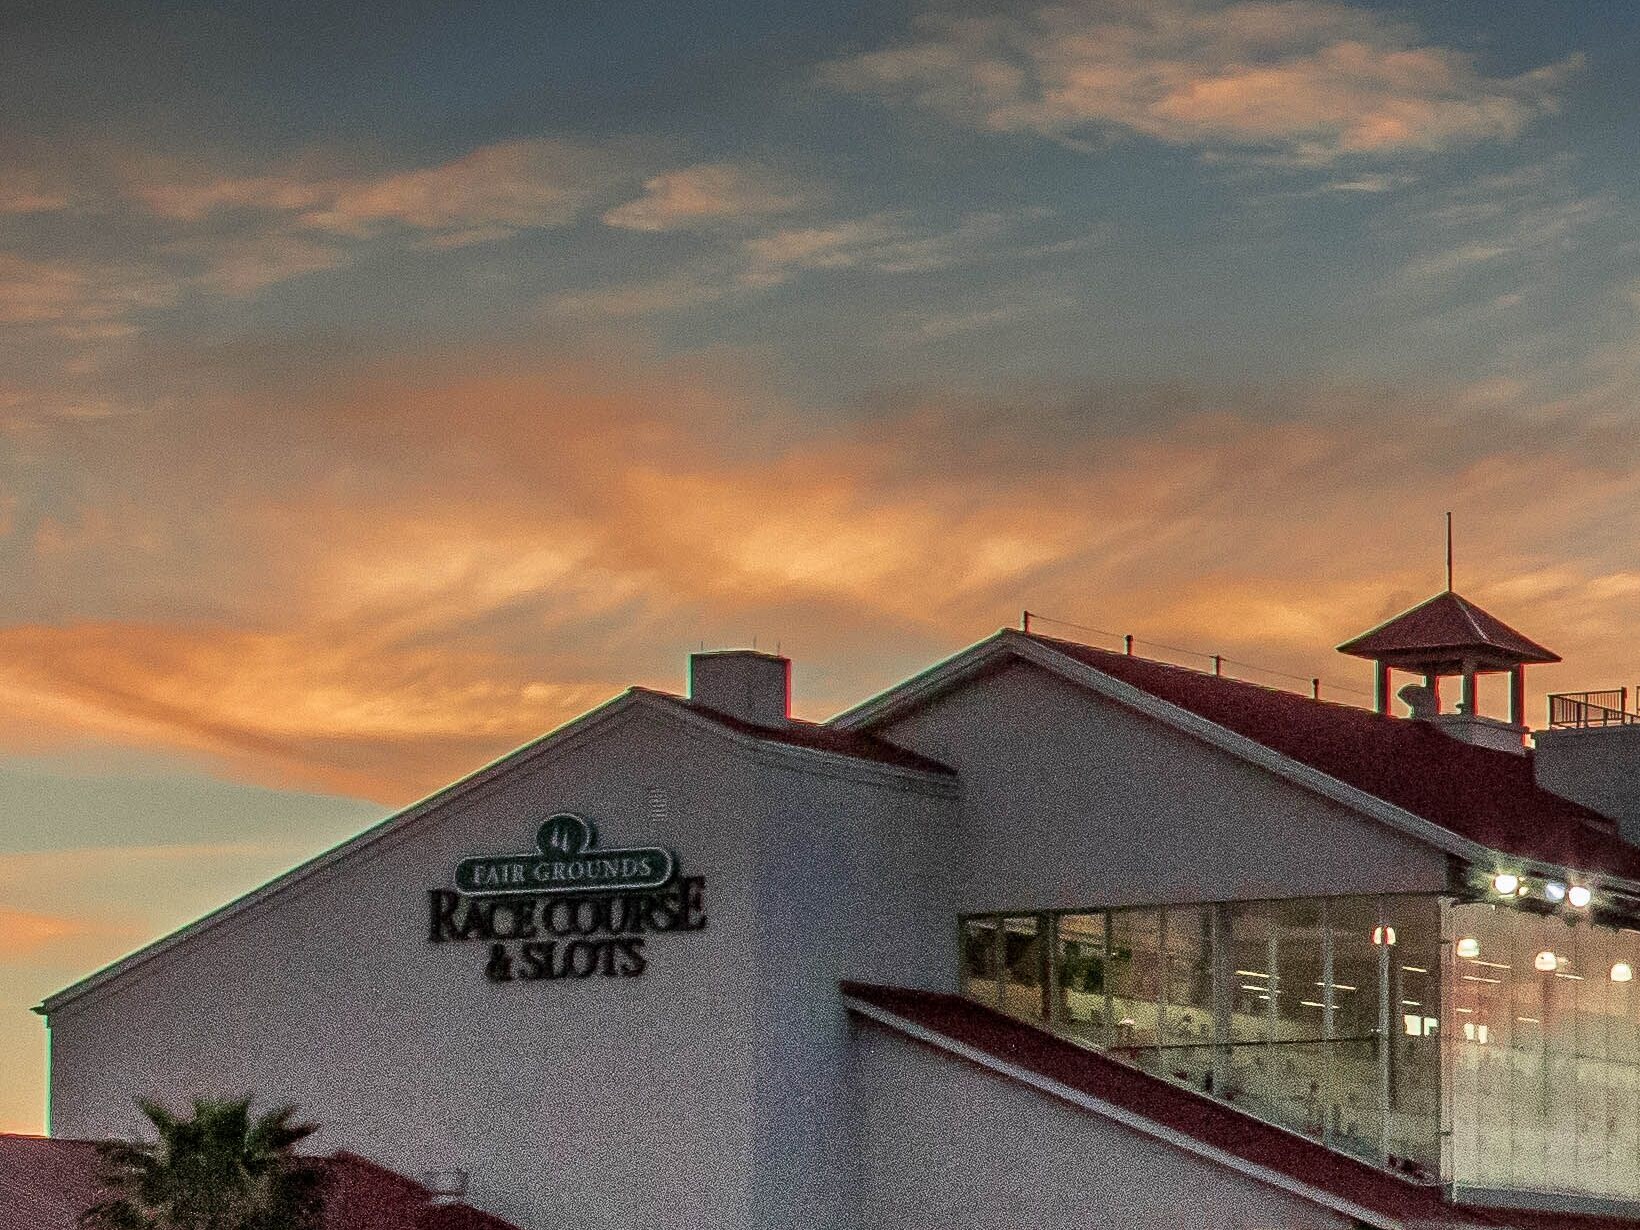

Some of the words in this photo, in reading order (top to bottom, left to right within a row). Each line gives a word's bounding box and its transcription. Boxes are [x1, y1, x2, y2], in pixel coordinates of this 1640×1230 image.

[473, 865, 525, 885] FAIR
[533, 858, 652, 881] GROUNDS
[428, 890, 537, 942] RACE
[543, 876, 709, 935] COURSE
[485, 943, 513, 982] &
[517, 937, 648, 980] SLOTS
